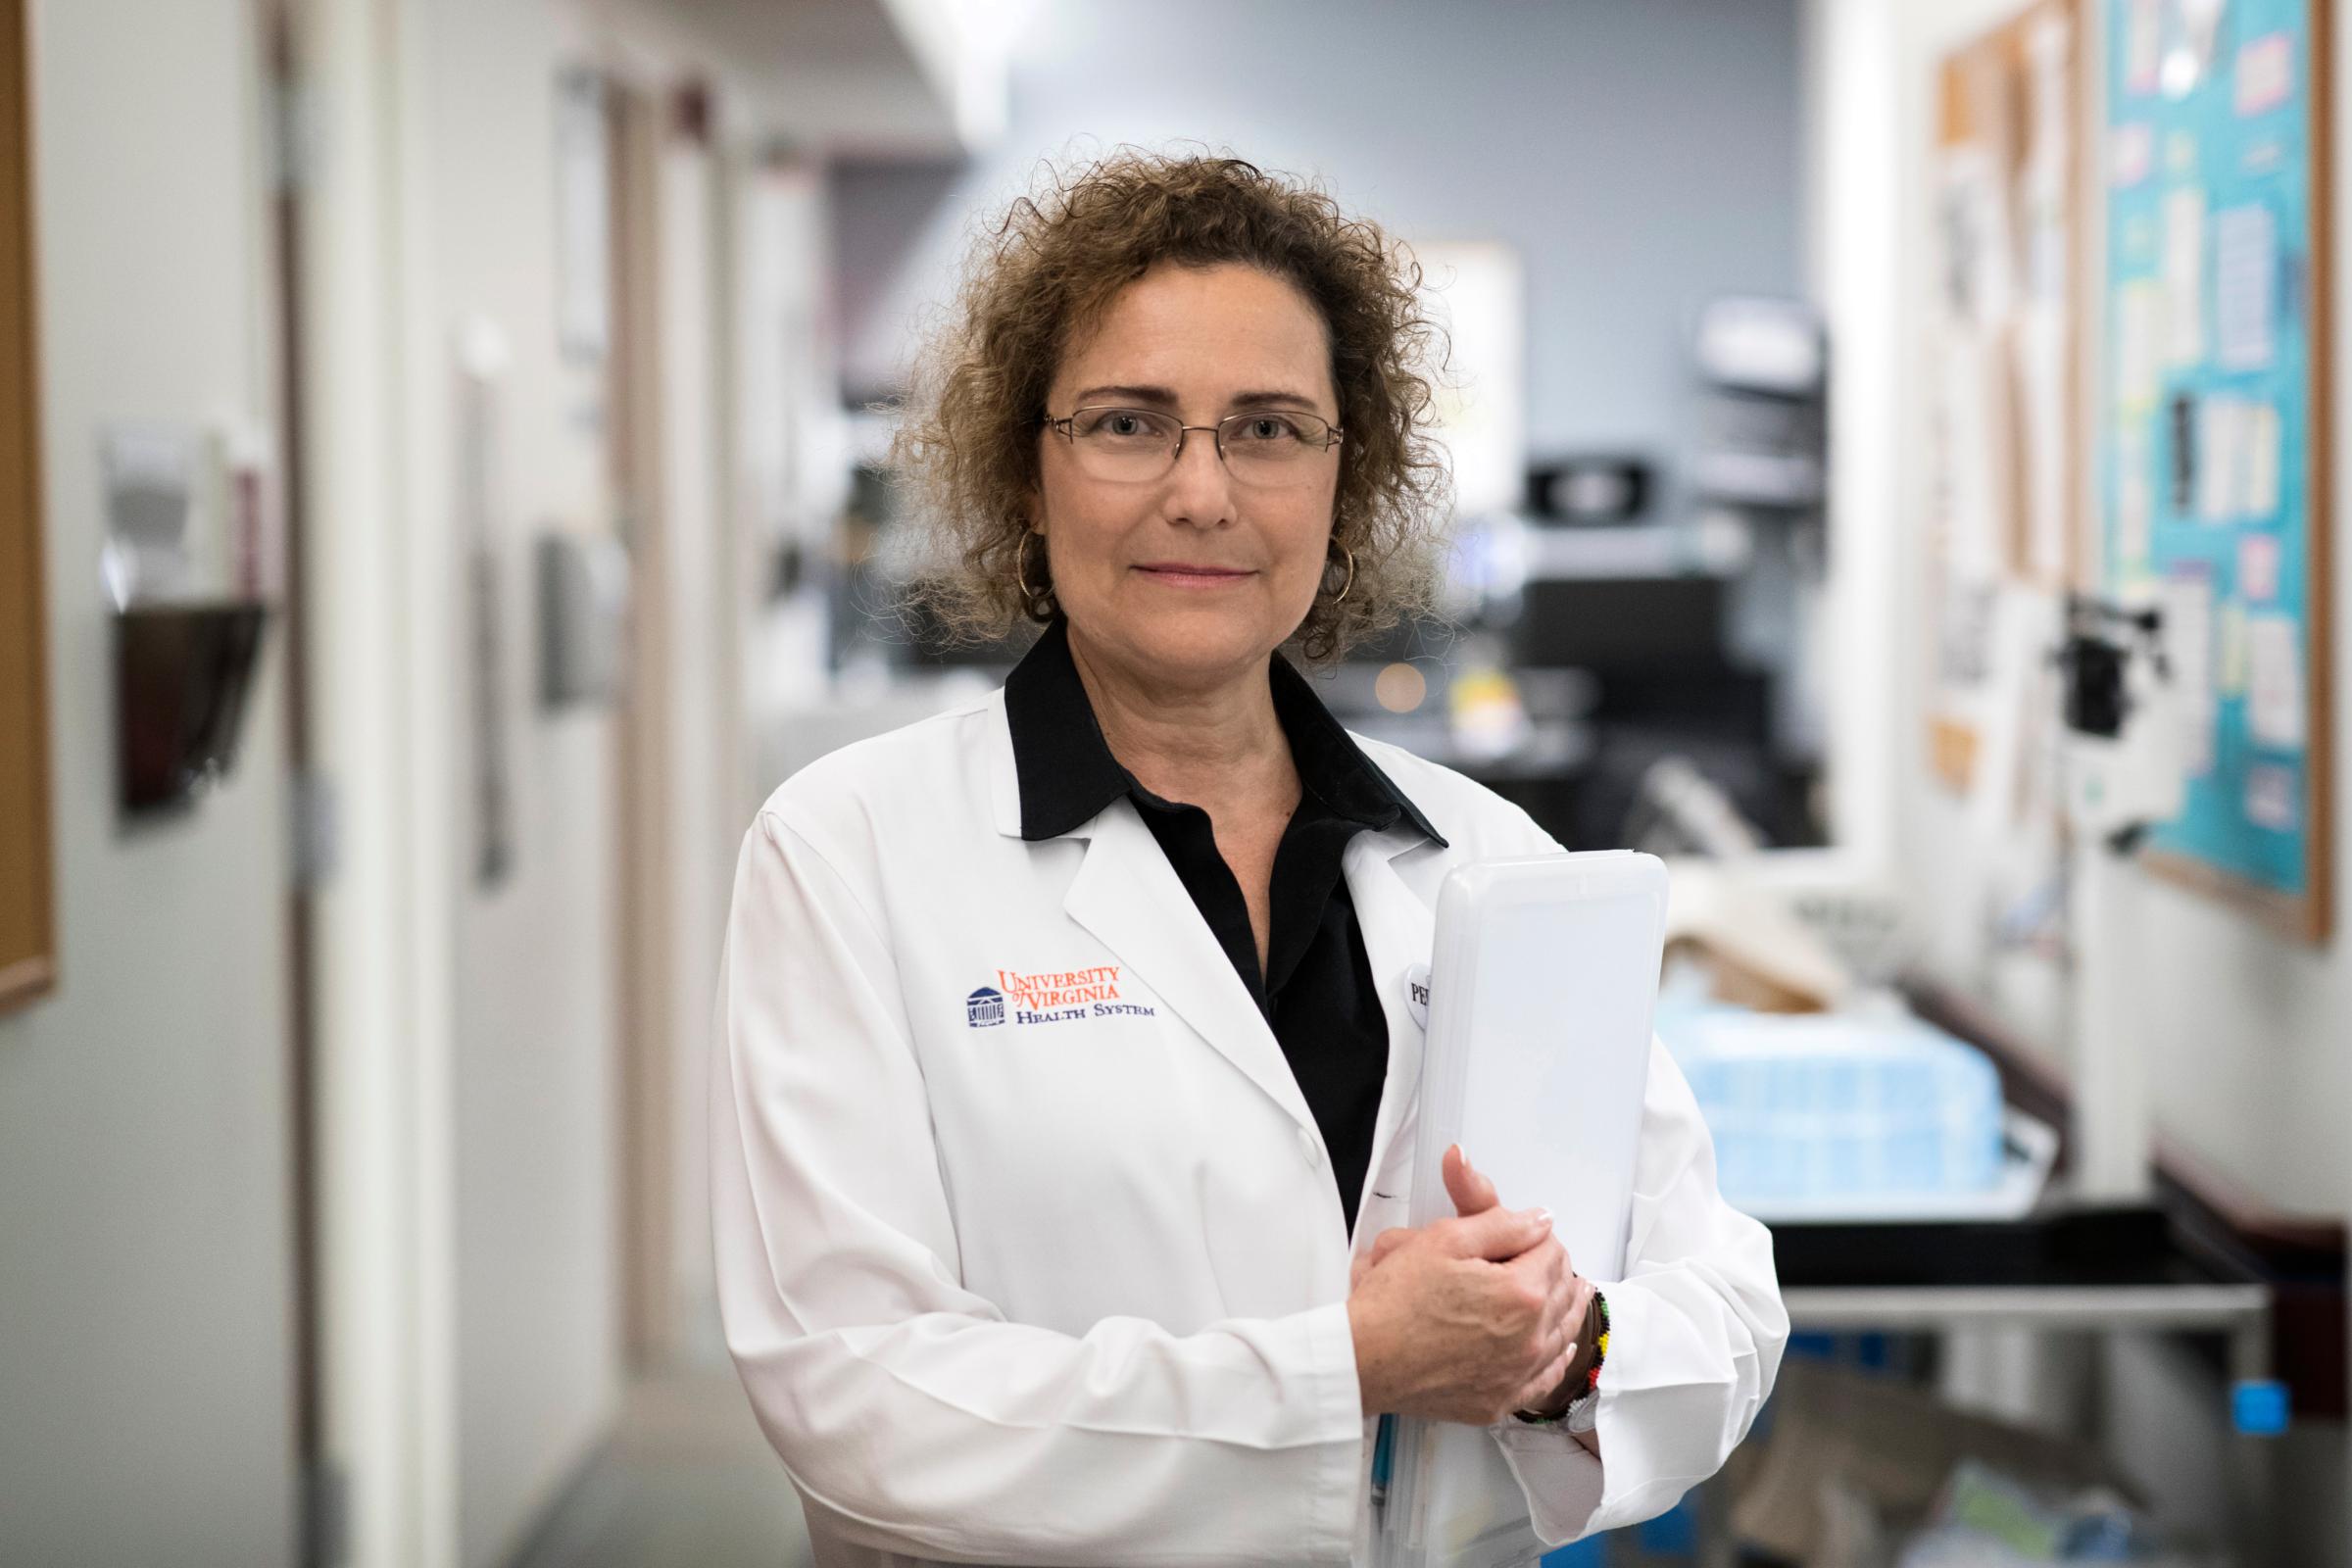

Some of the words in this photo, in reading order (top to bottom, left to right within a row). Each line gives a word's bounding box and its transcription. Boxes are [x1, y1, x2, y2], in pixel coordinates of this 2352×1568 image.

[997, 966, 1120, 994] UNIVERSITY
[1012, 990, 1026, 1007] of
[1025, 984, 1119, 1010] VIRGINIA
[1016, 1008, 1086, 1024] HEALTH
[1094, 1004, 1154, 1016] SYSTEM
